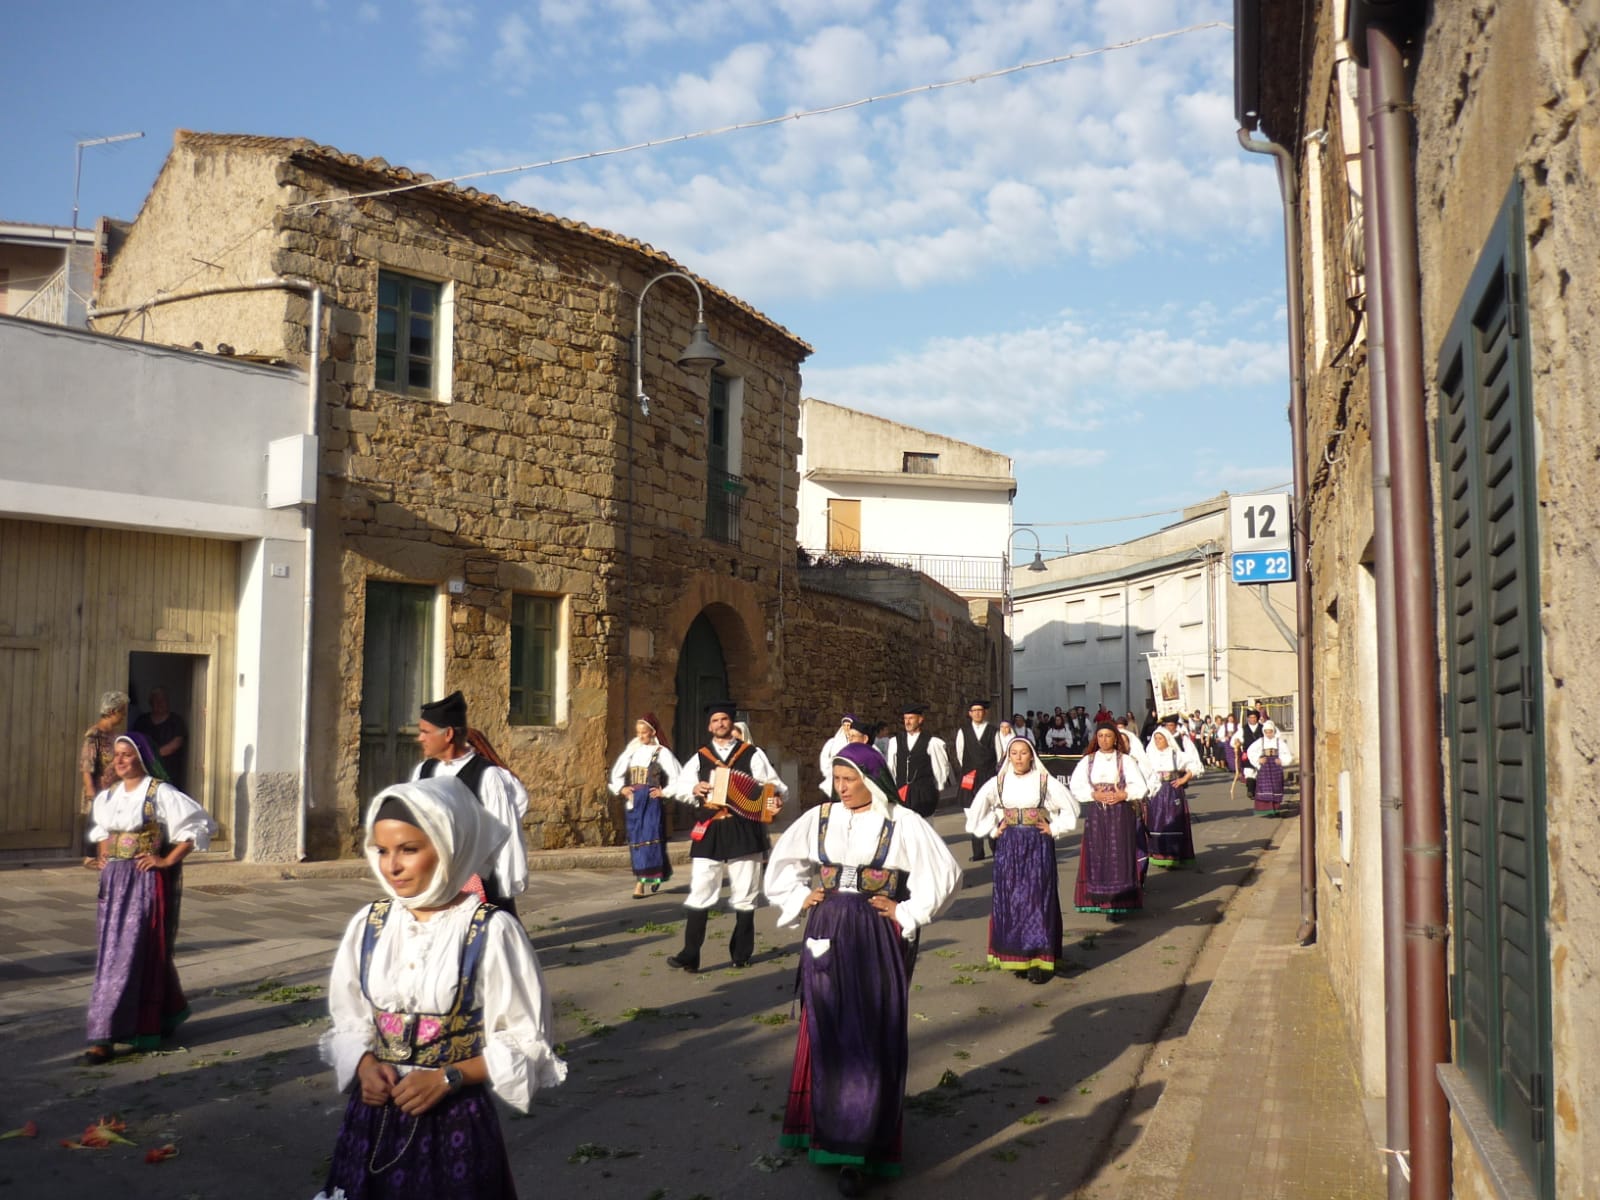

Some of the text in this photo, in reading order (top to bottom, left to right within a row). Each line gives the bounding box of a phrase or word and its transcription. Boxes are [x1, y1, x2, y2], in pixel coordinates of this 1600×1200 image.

[1243, 504, 1276, 539] 12
[1235, 557, 1287, 576] SP 22
